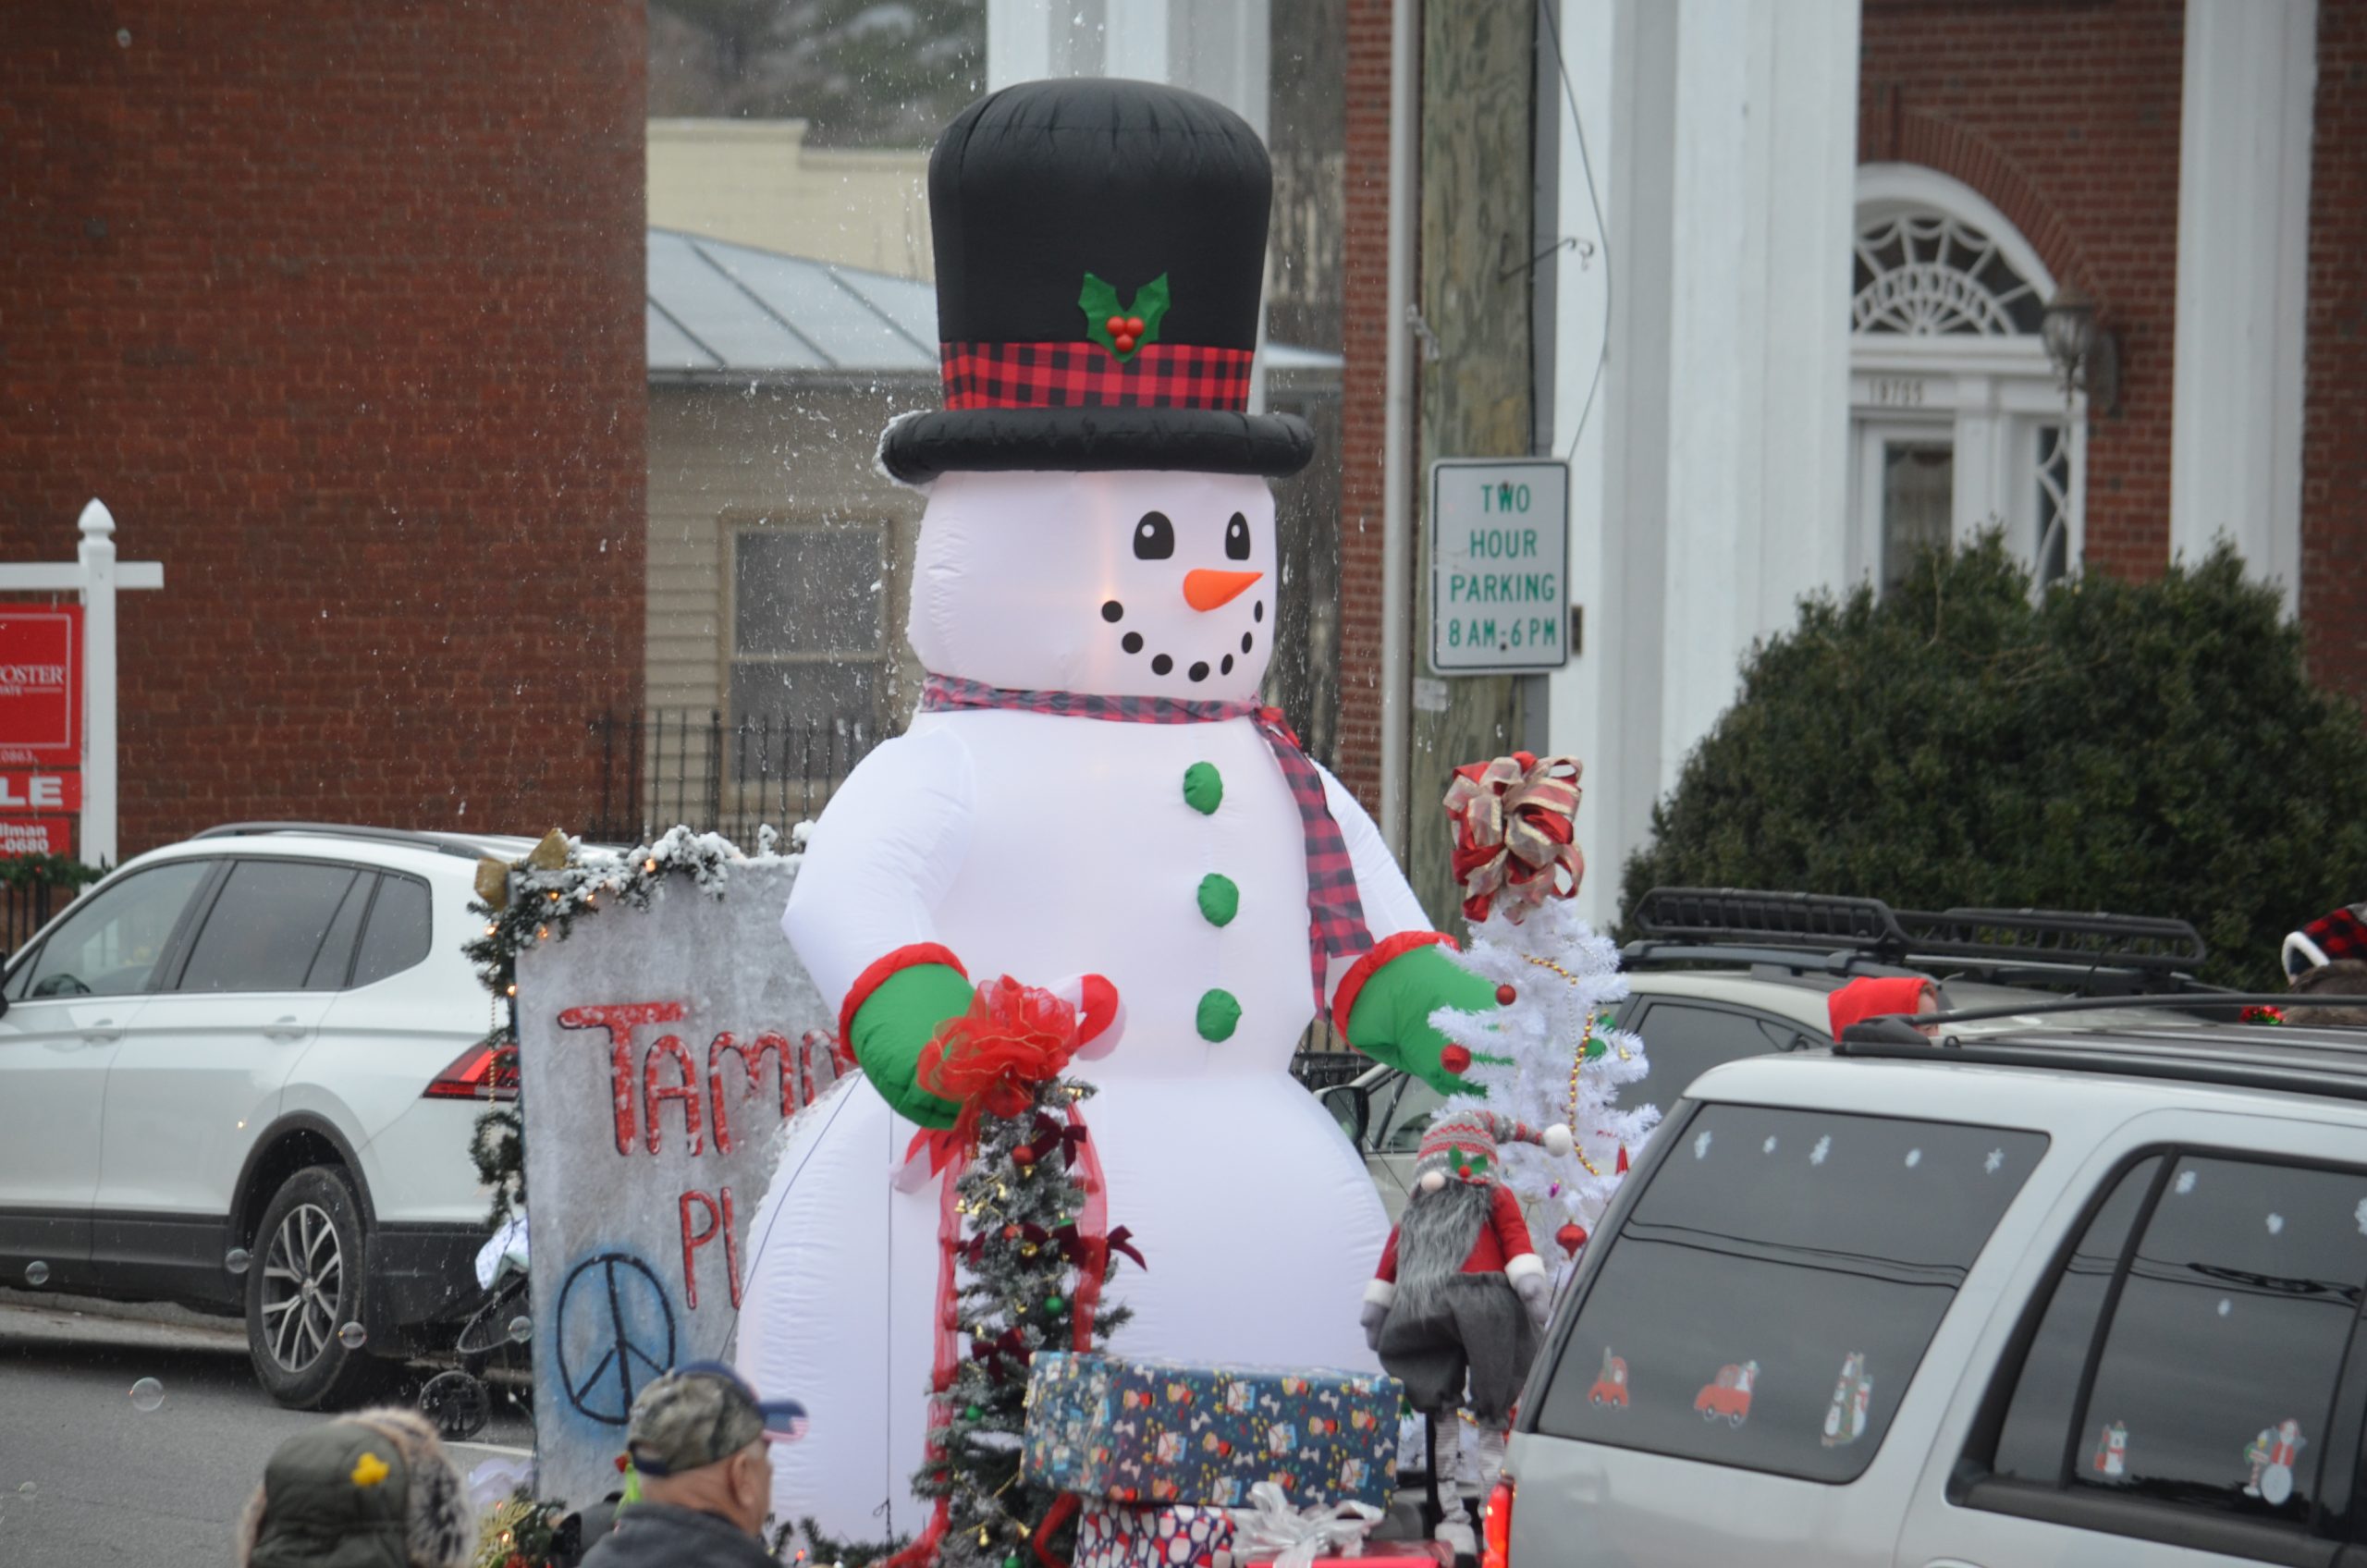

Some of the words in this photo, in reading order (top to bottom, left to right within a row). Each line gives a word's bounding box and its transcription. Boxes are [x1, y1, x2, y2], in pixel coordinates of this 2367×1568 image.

[1481, 484, 1530, 513] TWO
[1470, 530, 1537, 557] HOUR
[1451, 573, 1555, 602] PARKING
[1449, 619, 1461, 647] 8
[1528, 617, 1556, 646] PM
[0, 777, 63, 806] LE
